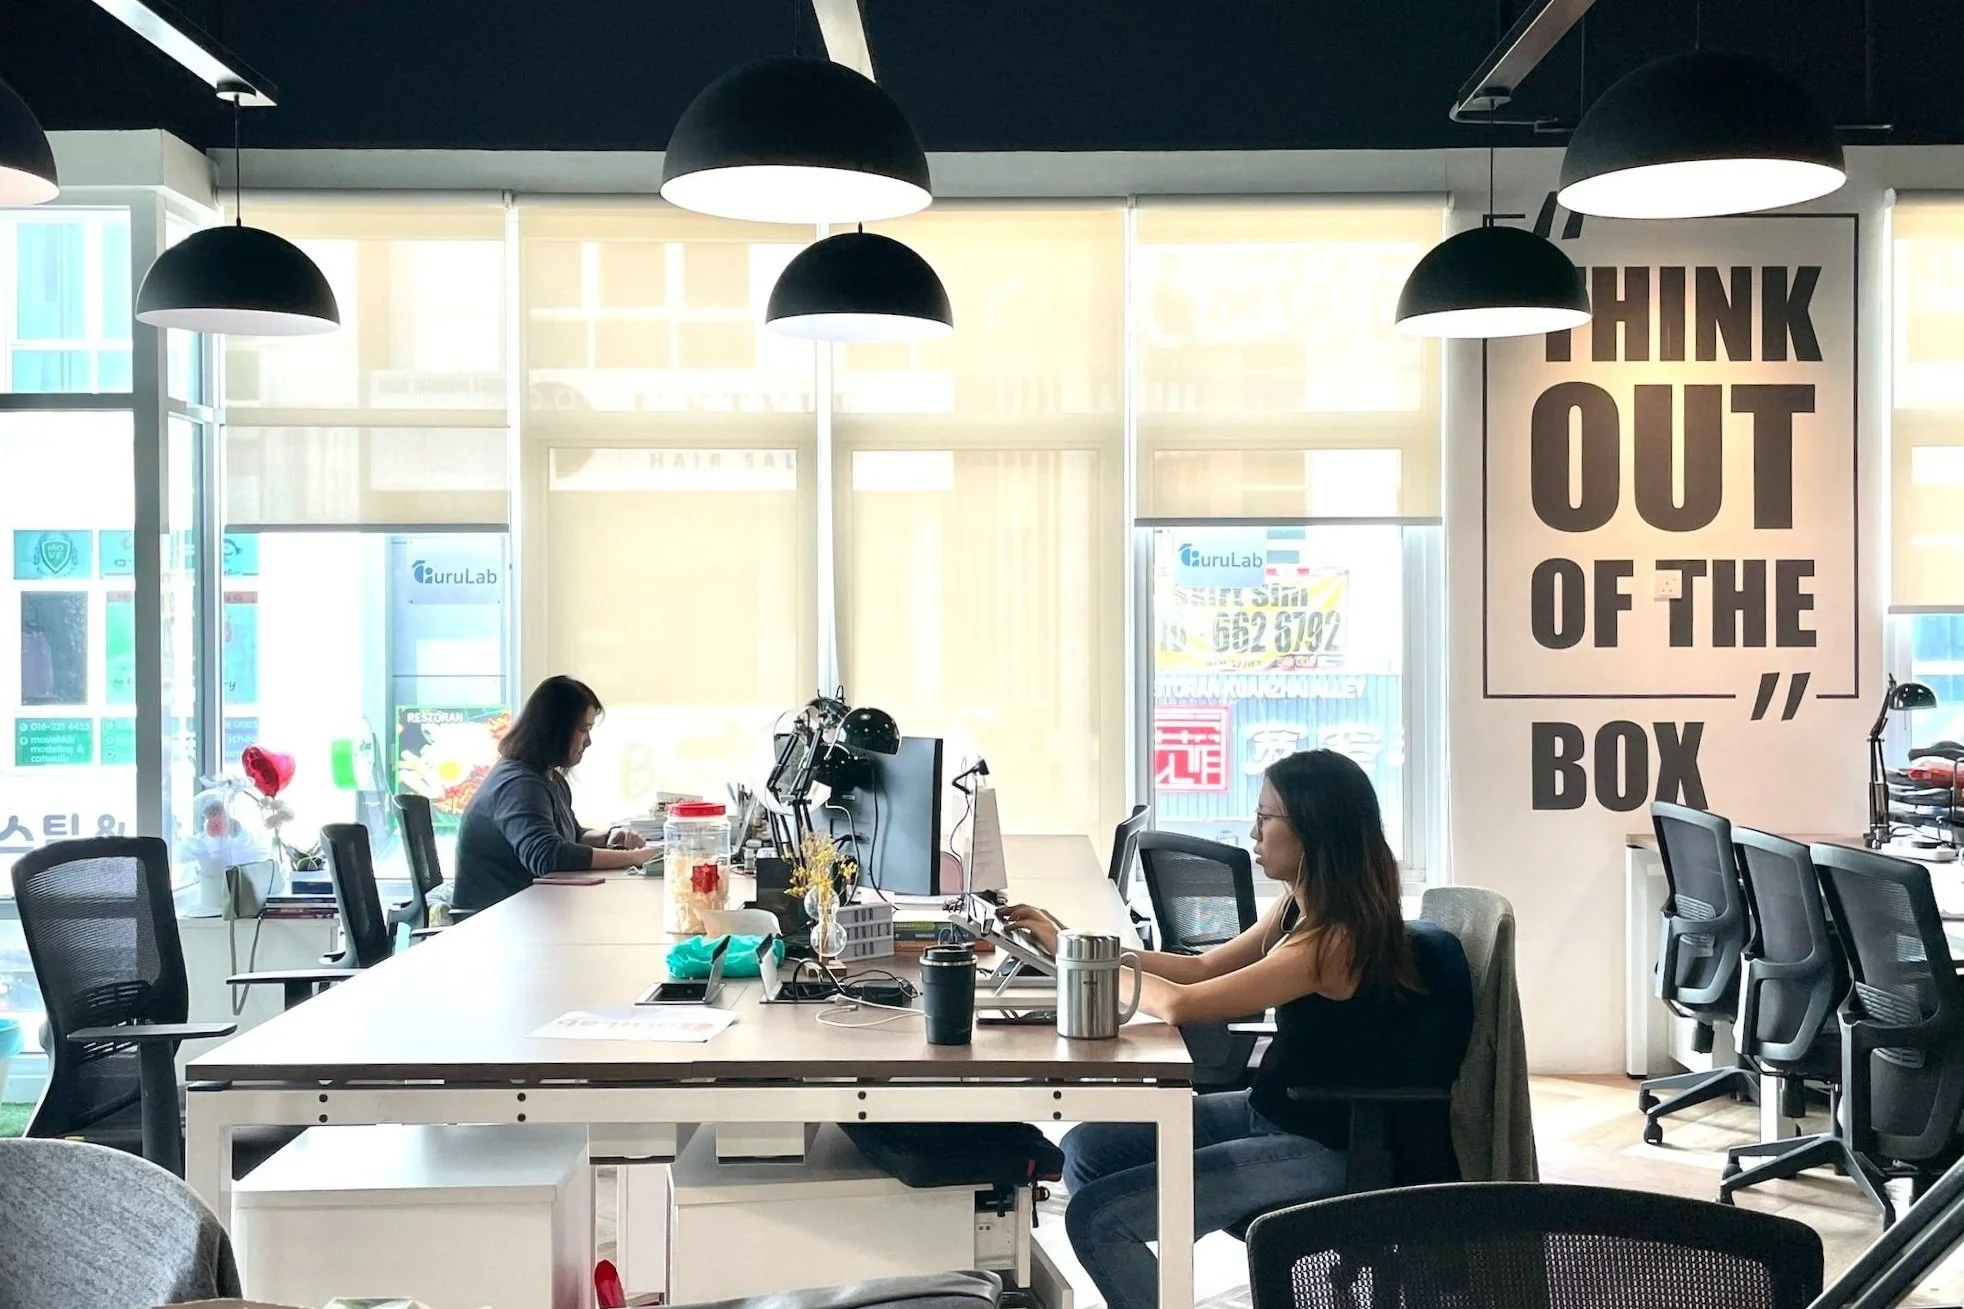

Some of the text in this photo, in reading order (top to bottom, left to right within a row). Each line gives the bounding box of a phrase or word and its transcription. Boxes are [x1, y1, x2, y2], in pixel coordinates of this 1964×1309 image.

[1531, 382, 1815, 532] OUT
[412, 560, 497, 584] GuruLab
[1178, 543, 1263, 568] GuruLab
[1531, 558, 1817, 649] OF THE
[1274, 610, 1342, 653] 6792
[406, 712, 464, 724] RESTORAN
[1531, 720, 1708, 811] BOX
